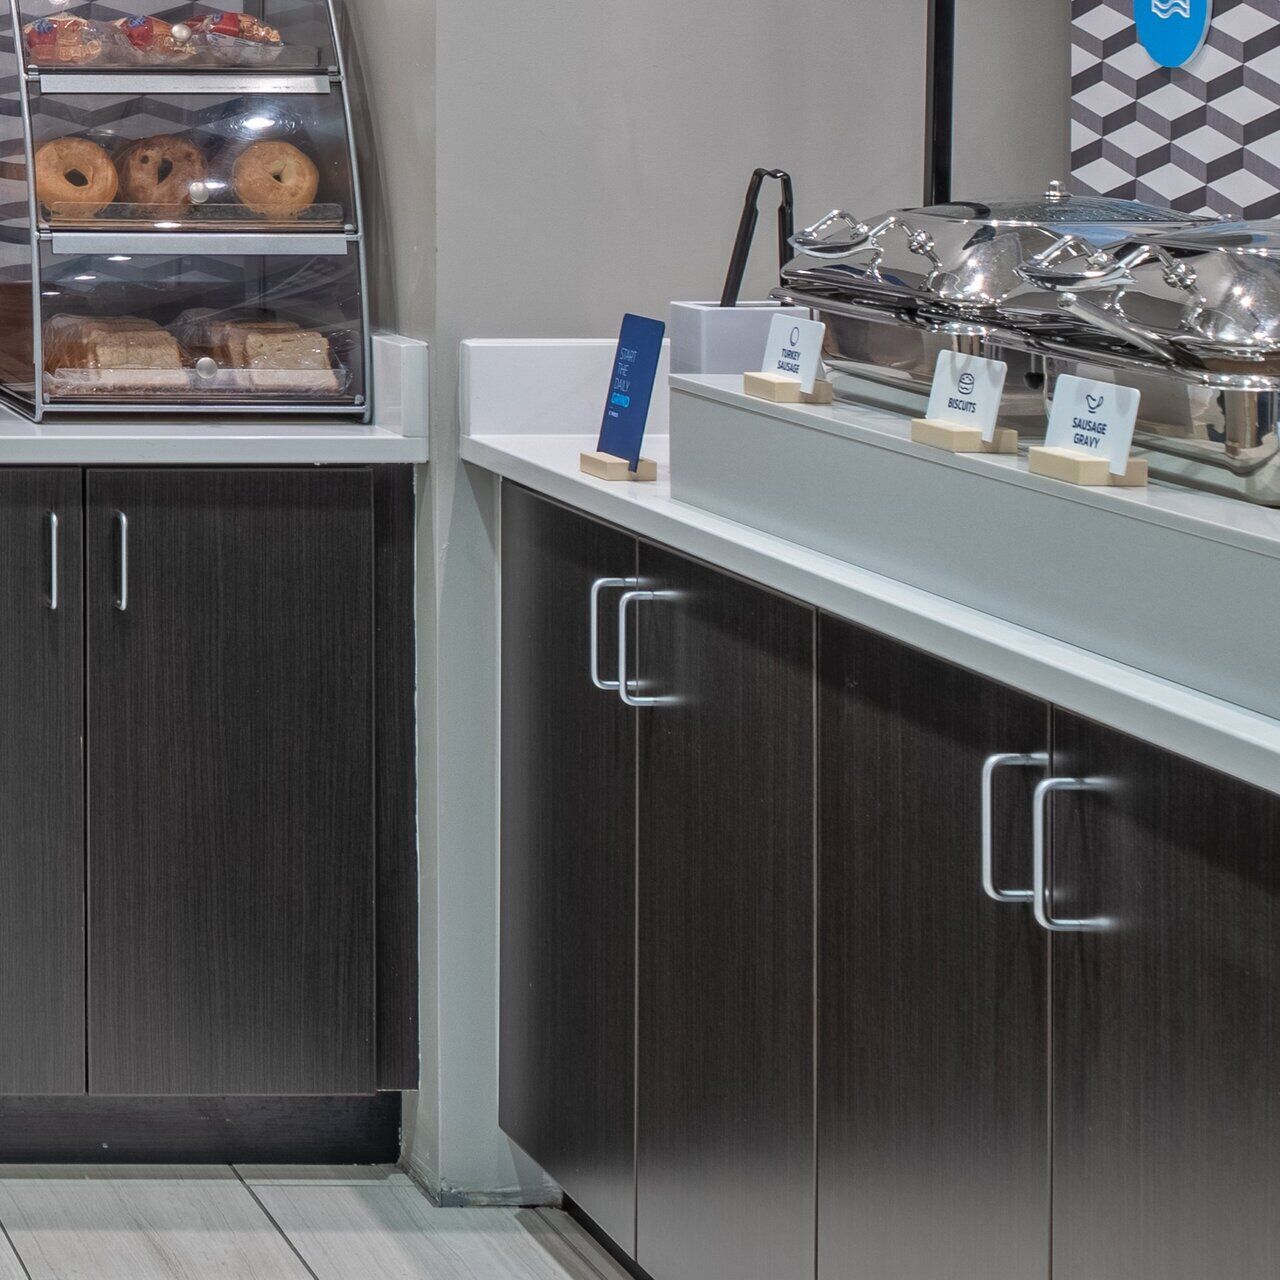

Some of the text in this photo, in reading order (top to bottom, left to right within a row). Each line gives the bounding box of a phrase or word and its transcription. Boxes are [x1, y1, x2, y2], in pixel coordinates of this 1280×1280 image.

[947, 397, 977, 413] BISCUITS
[1071, 417, 1108, 435] SAUSAGE
[1073, 433, 1101, 449] GRAVY
